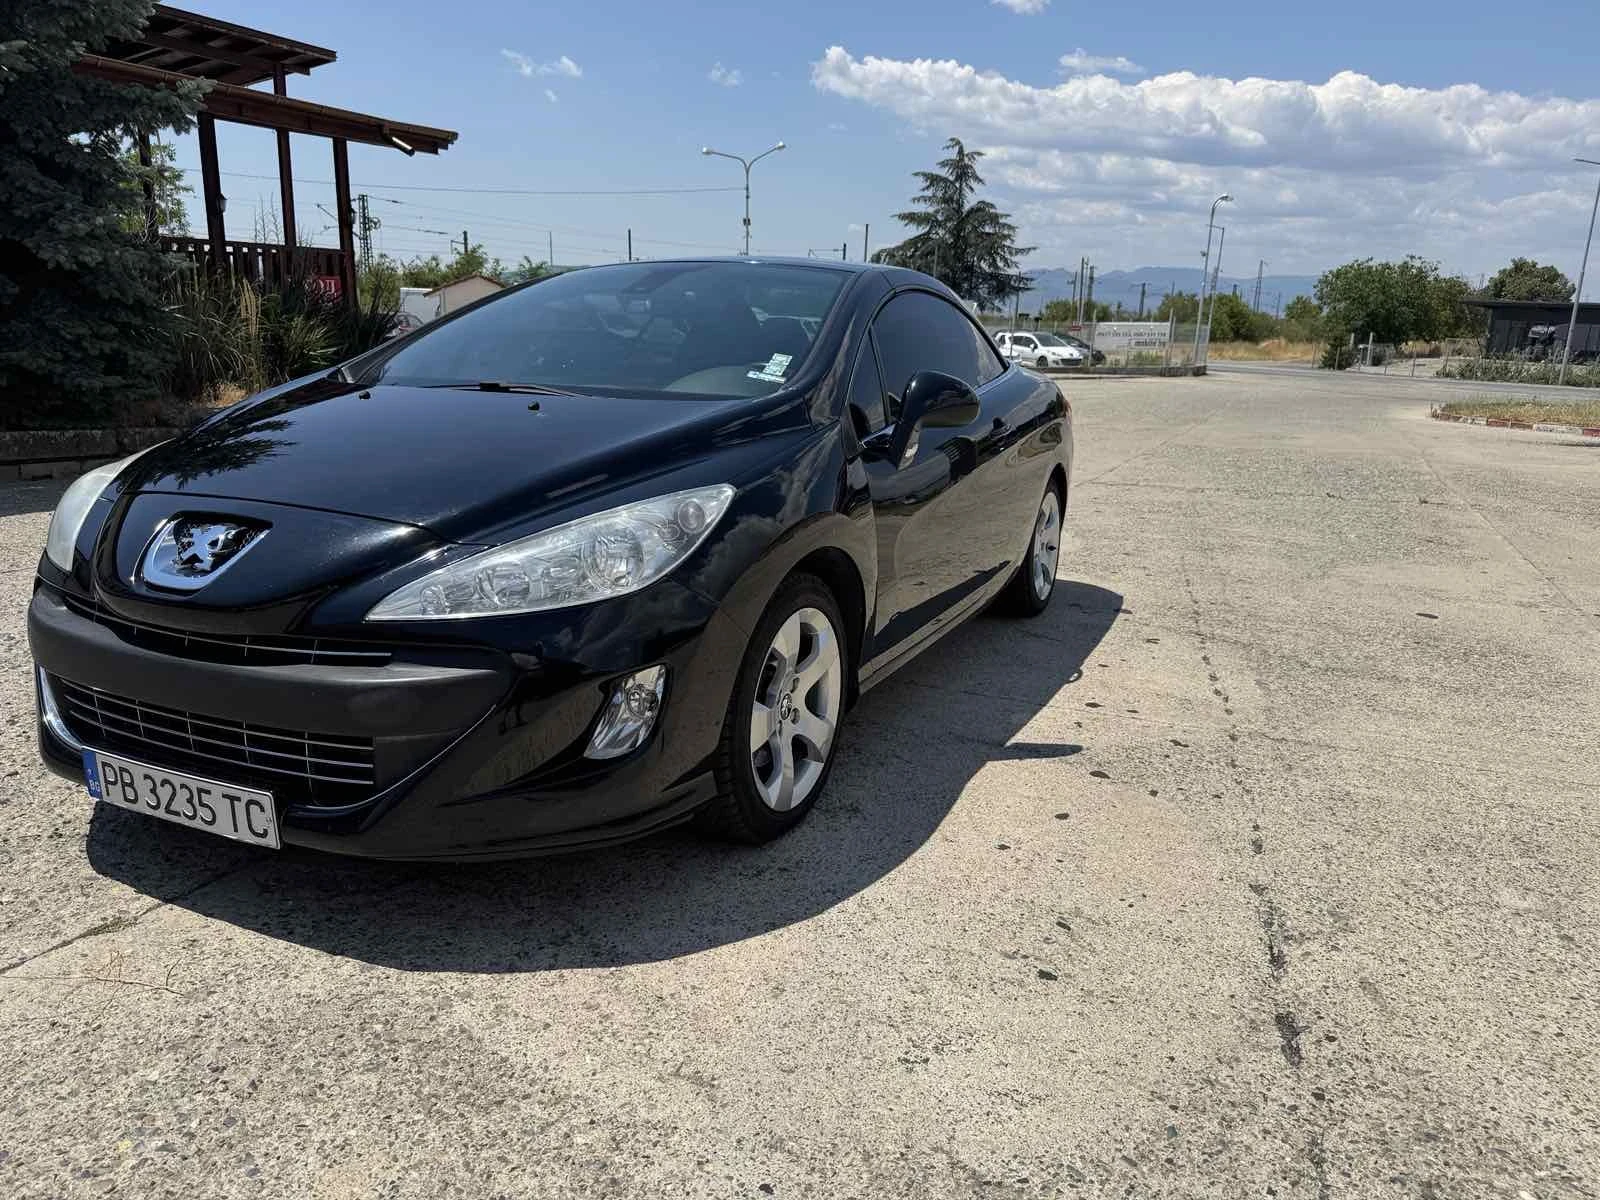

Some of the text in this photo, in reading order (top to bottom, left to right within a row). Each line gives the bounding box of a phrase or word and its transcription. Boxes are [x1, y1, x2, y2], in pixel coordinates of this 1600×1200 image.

[88, 779, 101, 792] BG
[101, 761, 269, 839] PB 3235 TC
